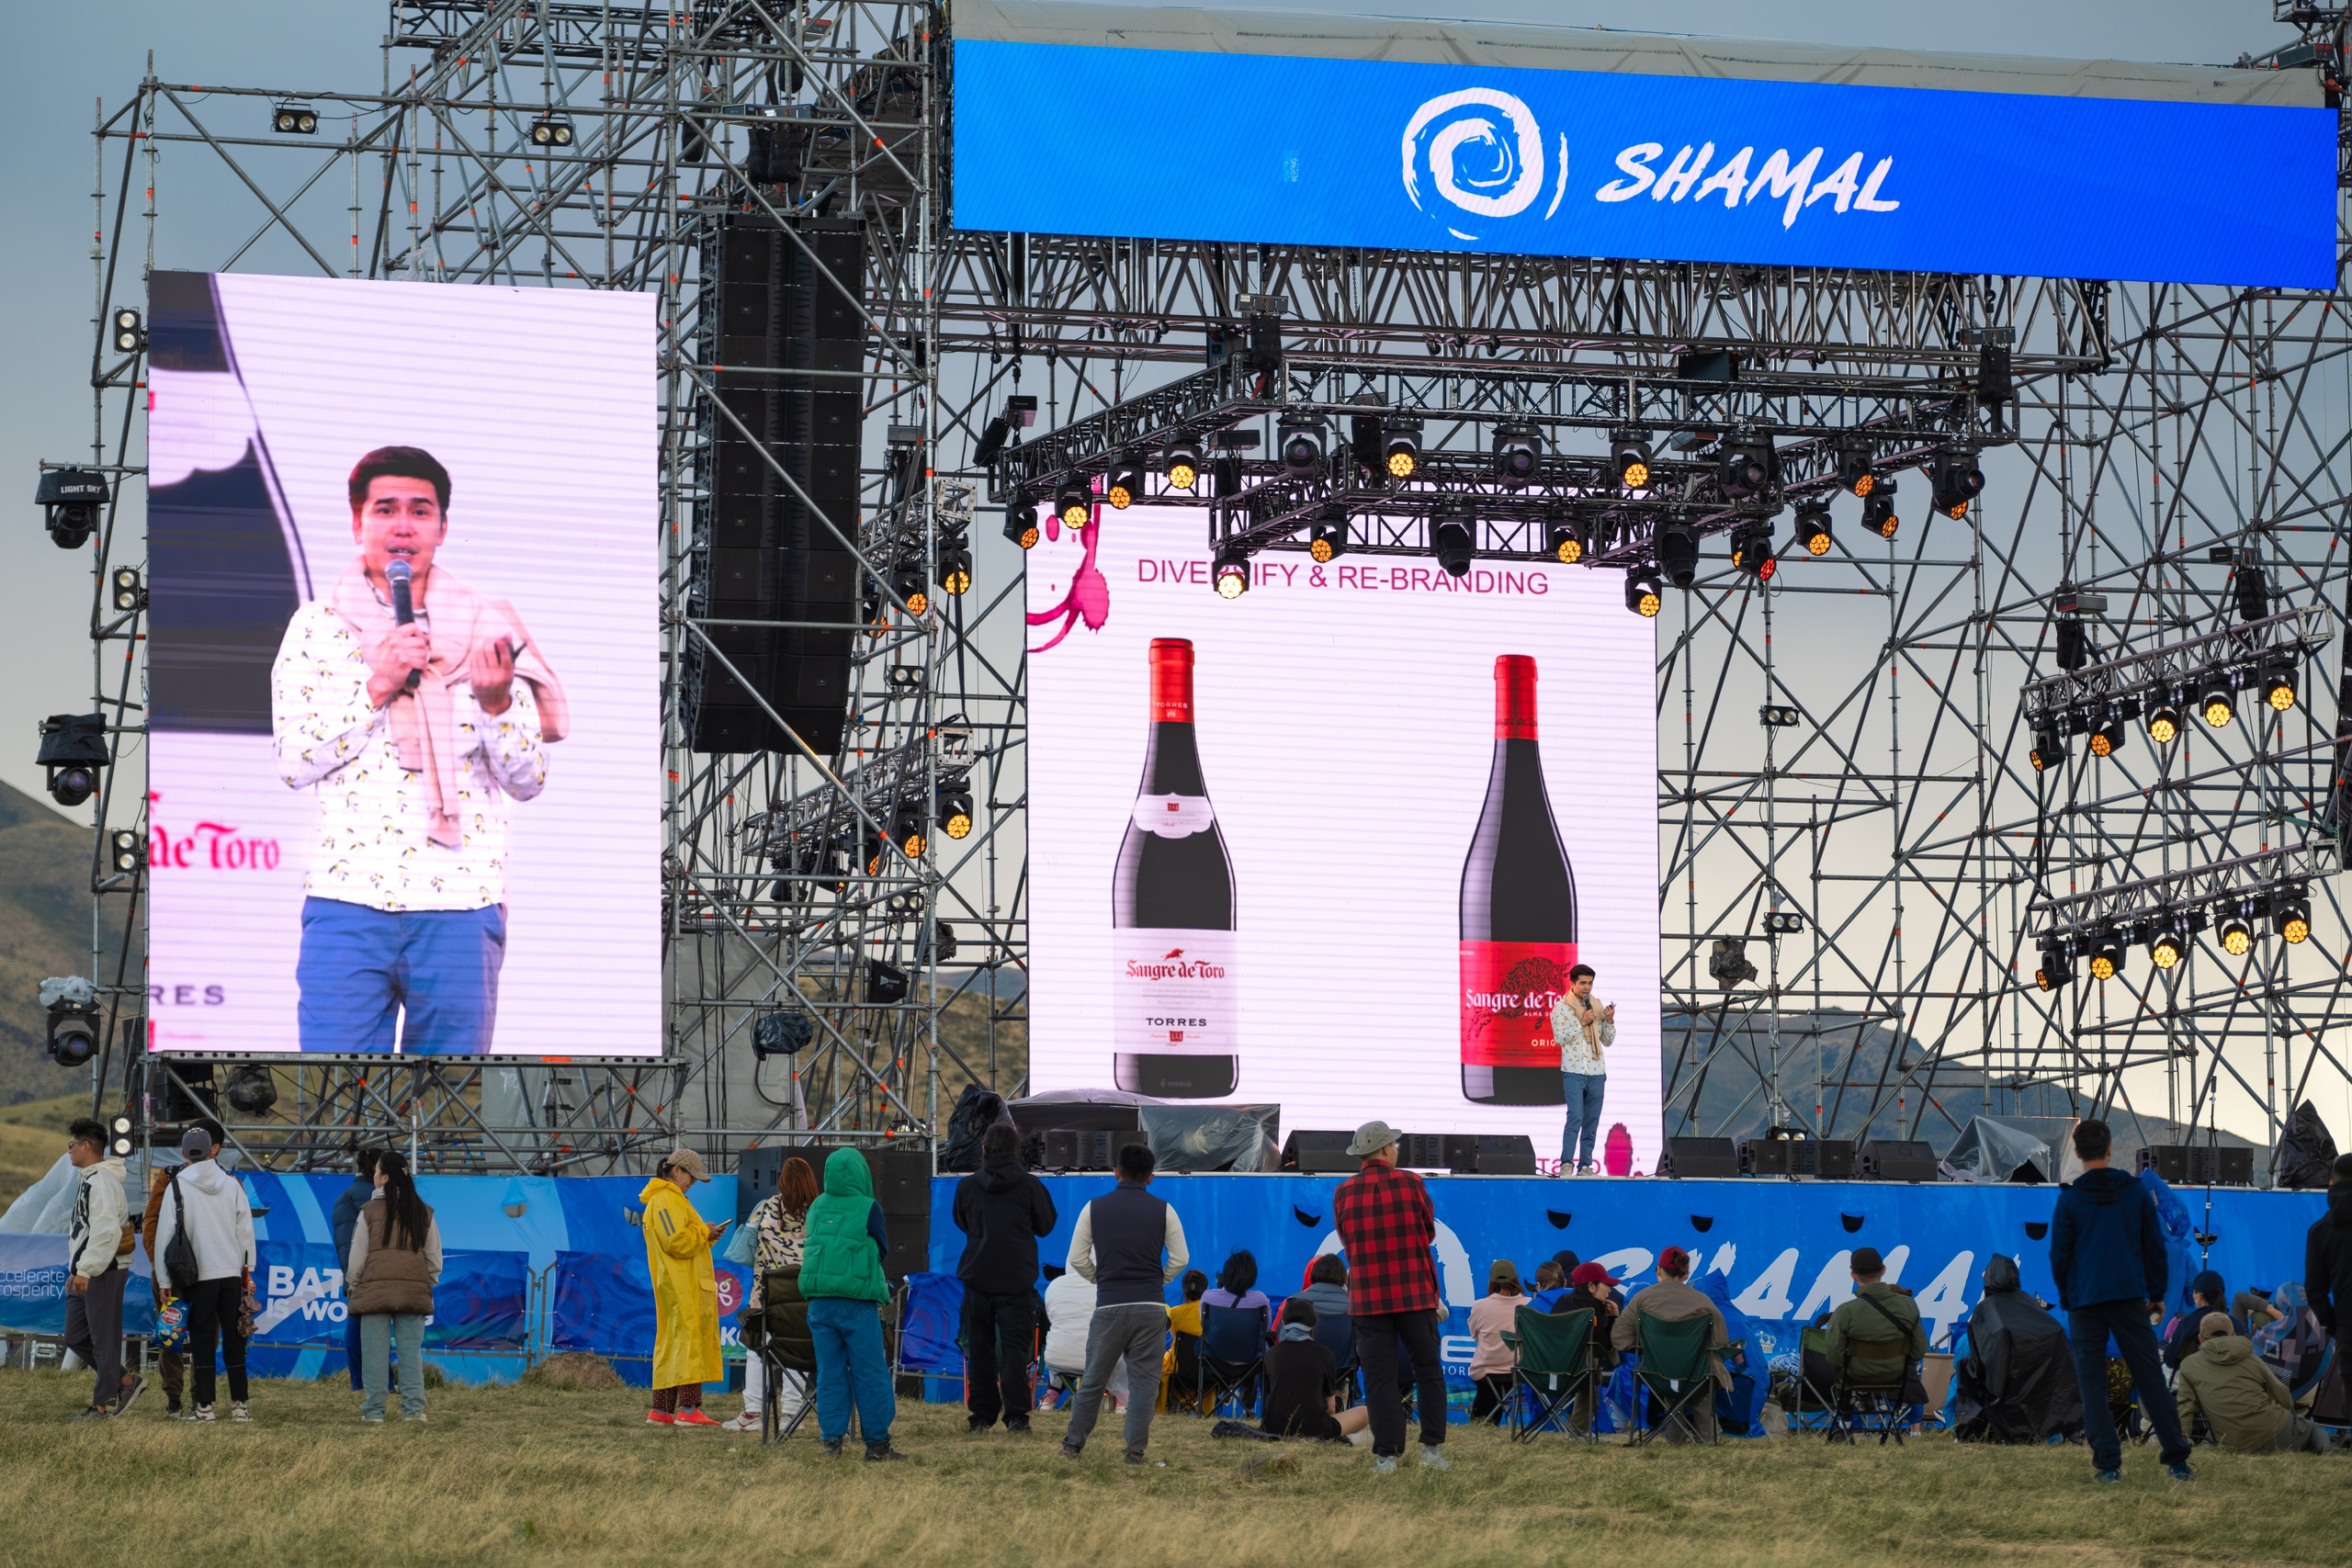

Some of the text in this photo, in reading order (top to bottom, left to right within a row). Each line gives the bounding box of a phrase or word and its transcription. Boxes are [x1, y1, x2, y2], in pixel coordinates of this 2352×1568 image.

[1595, 141, 1900, 232] SHAMAL
[61, 485, 101, 493] LIGHT SKY
[1309, 564, 1329, 588] &
[1339, 566, 1549, 595] RE-BRANDING
[195, 821, 279, 870] Toro
[1125, 959, 1224, 981] Sangre de Toro
[1465, 989, 1521, 1012] Sangre
[1524, 992, 1544, 1009] de
[1146, 1018, 1206, 1027] TORRES
[0, 1269, 65, 1282] ccelerate
[0, 1283, 65, 1300] osperity
[266, 1298, 290, 1318] IS
